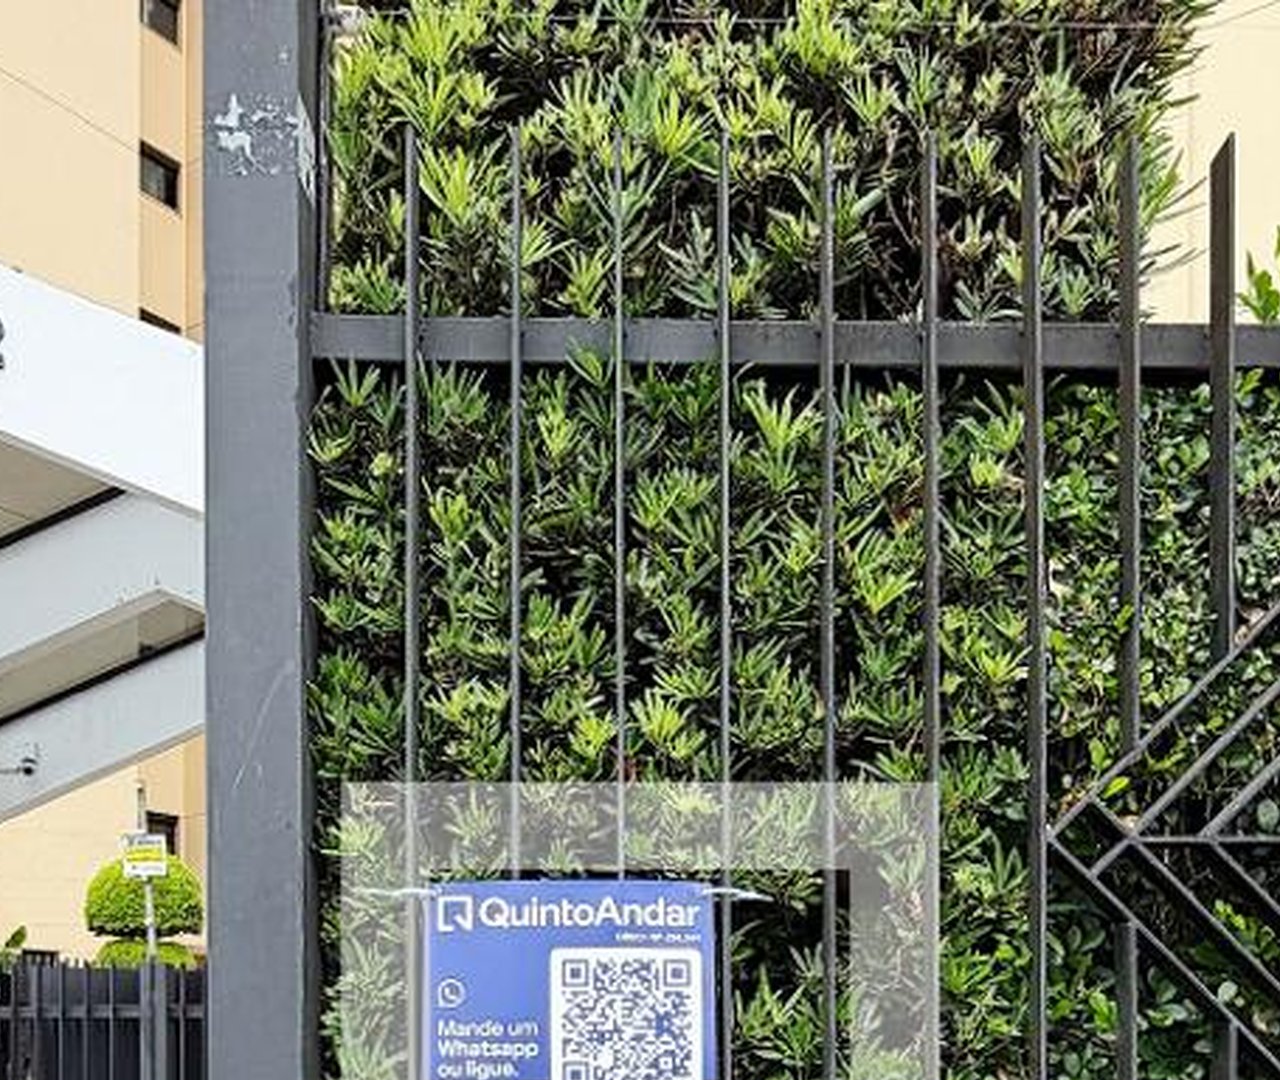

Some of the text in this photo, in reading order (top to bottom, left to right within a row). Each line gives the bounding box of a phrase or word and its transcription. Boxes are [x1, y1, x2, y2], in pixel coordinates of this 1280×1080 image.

[479, 896, 700, 929] QuintoAndar
[438, 1020, 538, 1037] Mande um
[438, 1039, 539, 1061] Whatsapp
[438, 1059, 518, 1080] ou ligue.
